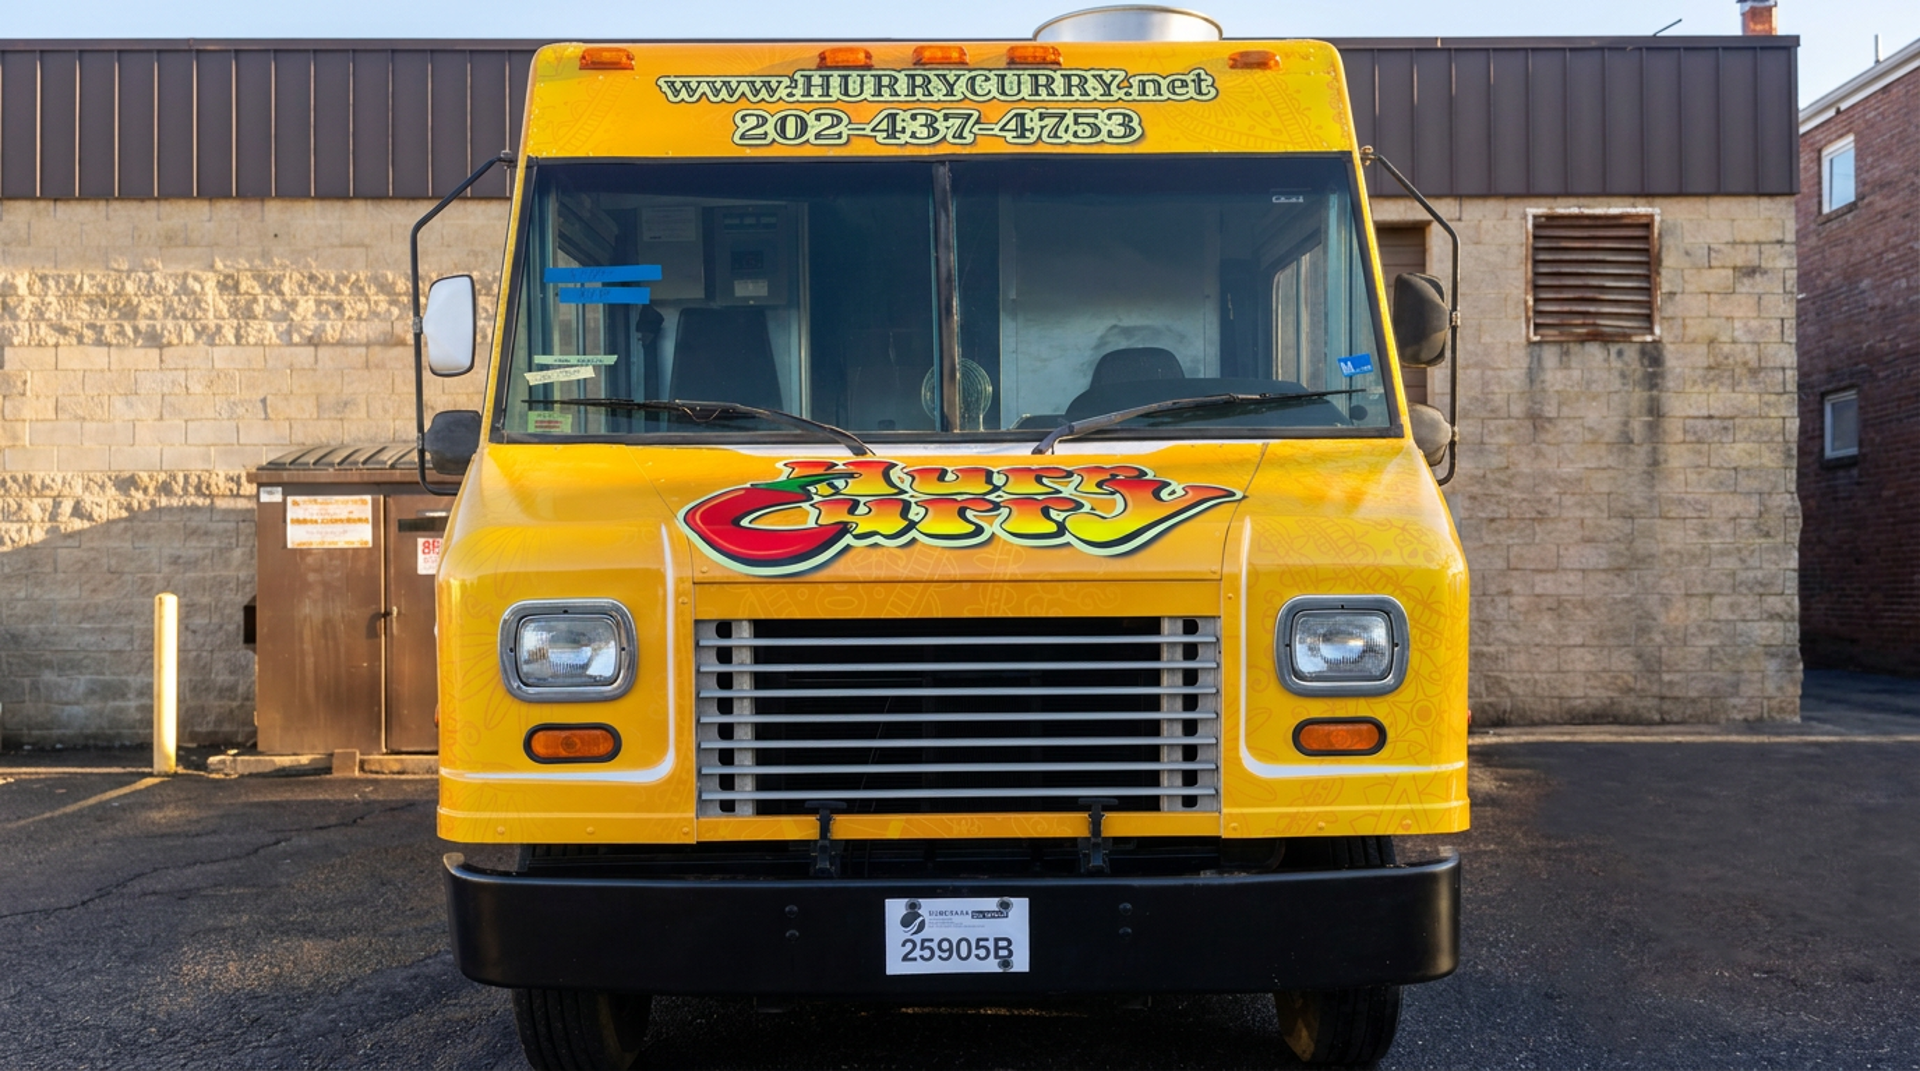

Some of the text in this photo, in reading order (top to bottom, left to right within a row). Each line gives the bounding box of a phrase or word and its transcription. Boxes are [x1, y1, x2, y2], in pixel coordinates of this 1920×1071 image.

[659, 71, 1216, 101] www.HURRYCURRY.net
[734, 109, 1143, 145] 202-437-4753
[901, 937, 1014, 962] 25905B
